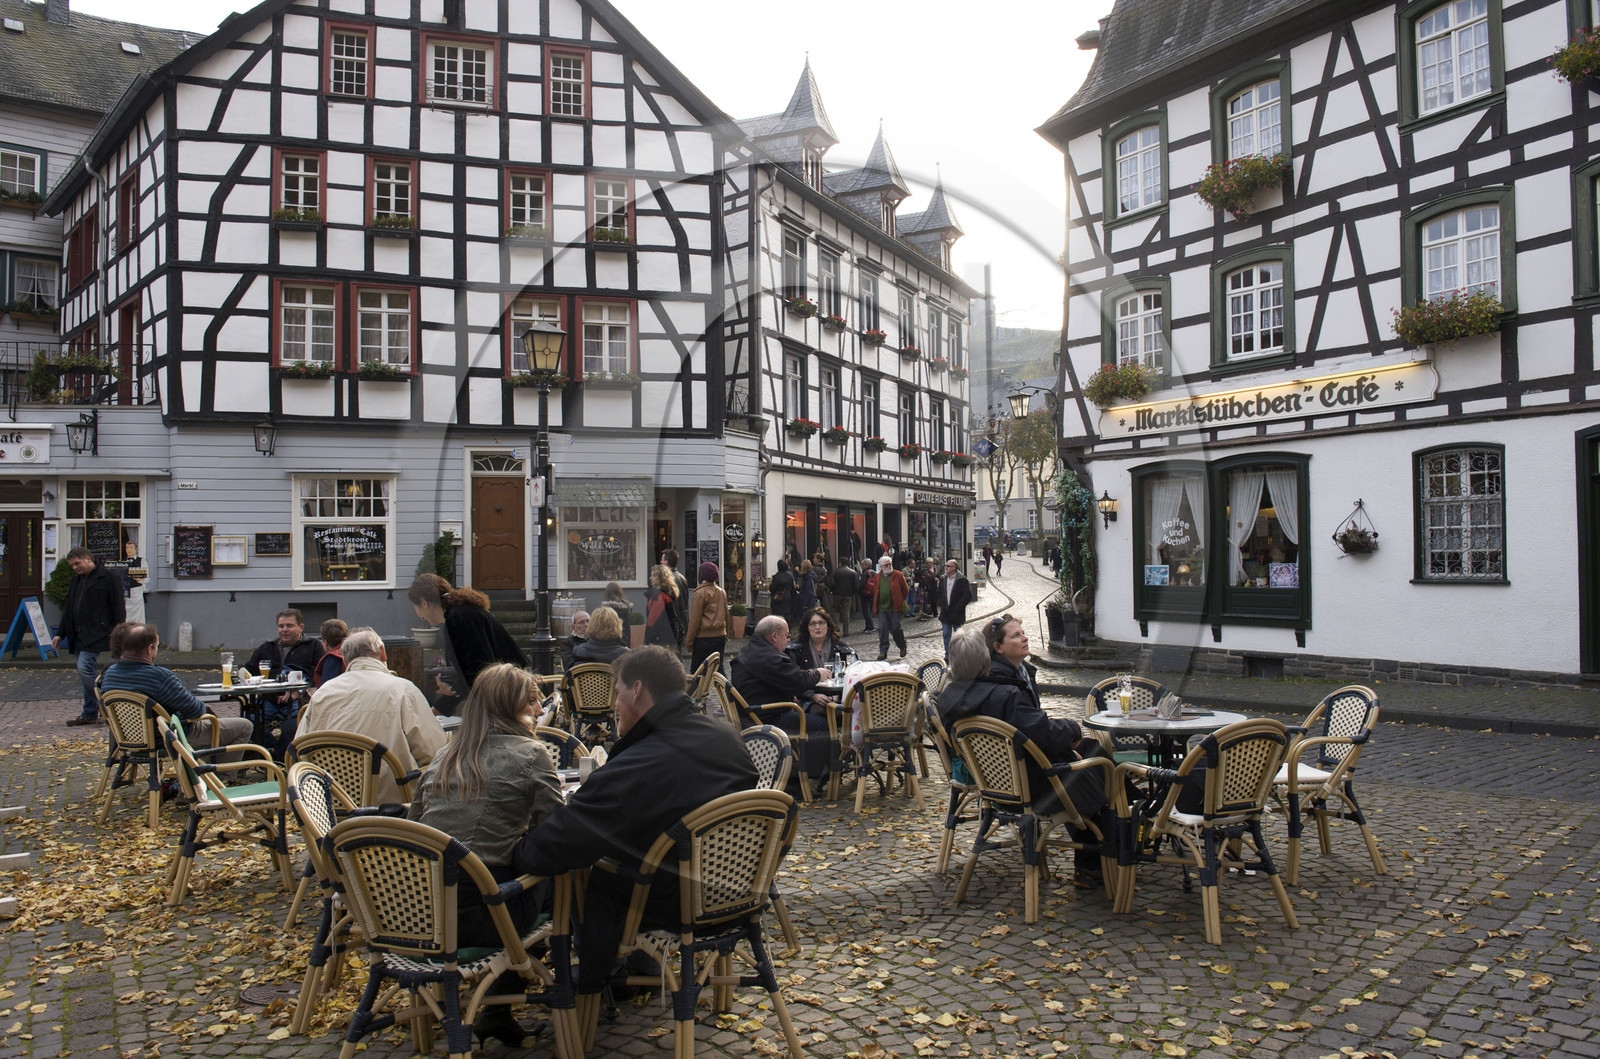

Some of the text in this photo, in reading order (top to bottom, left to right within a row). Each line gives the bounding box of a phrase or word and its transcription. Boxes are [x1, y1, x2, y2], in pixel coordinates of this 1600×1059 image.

[1319, 375, 1380, 408] Café
[916, 492, 948, 505] CAMERAS
[1161, 517, 1190, 530] Kaffee
[1169, 528, 1184, 537] und
[1162, 534, 1191, 546] Kuchen
